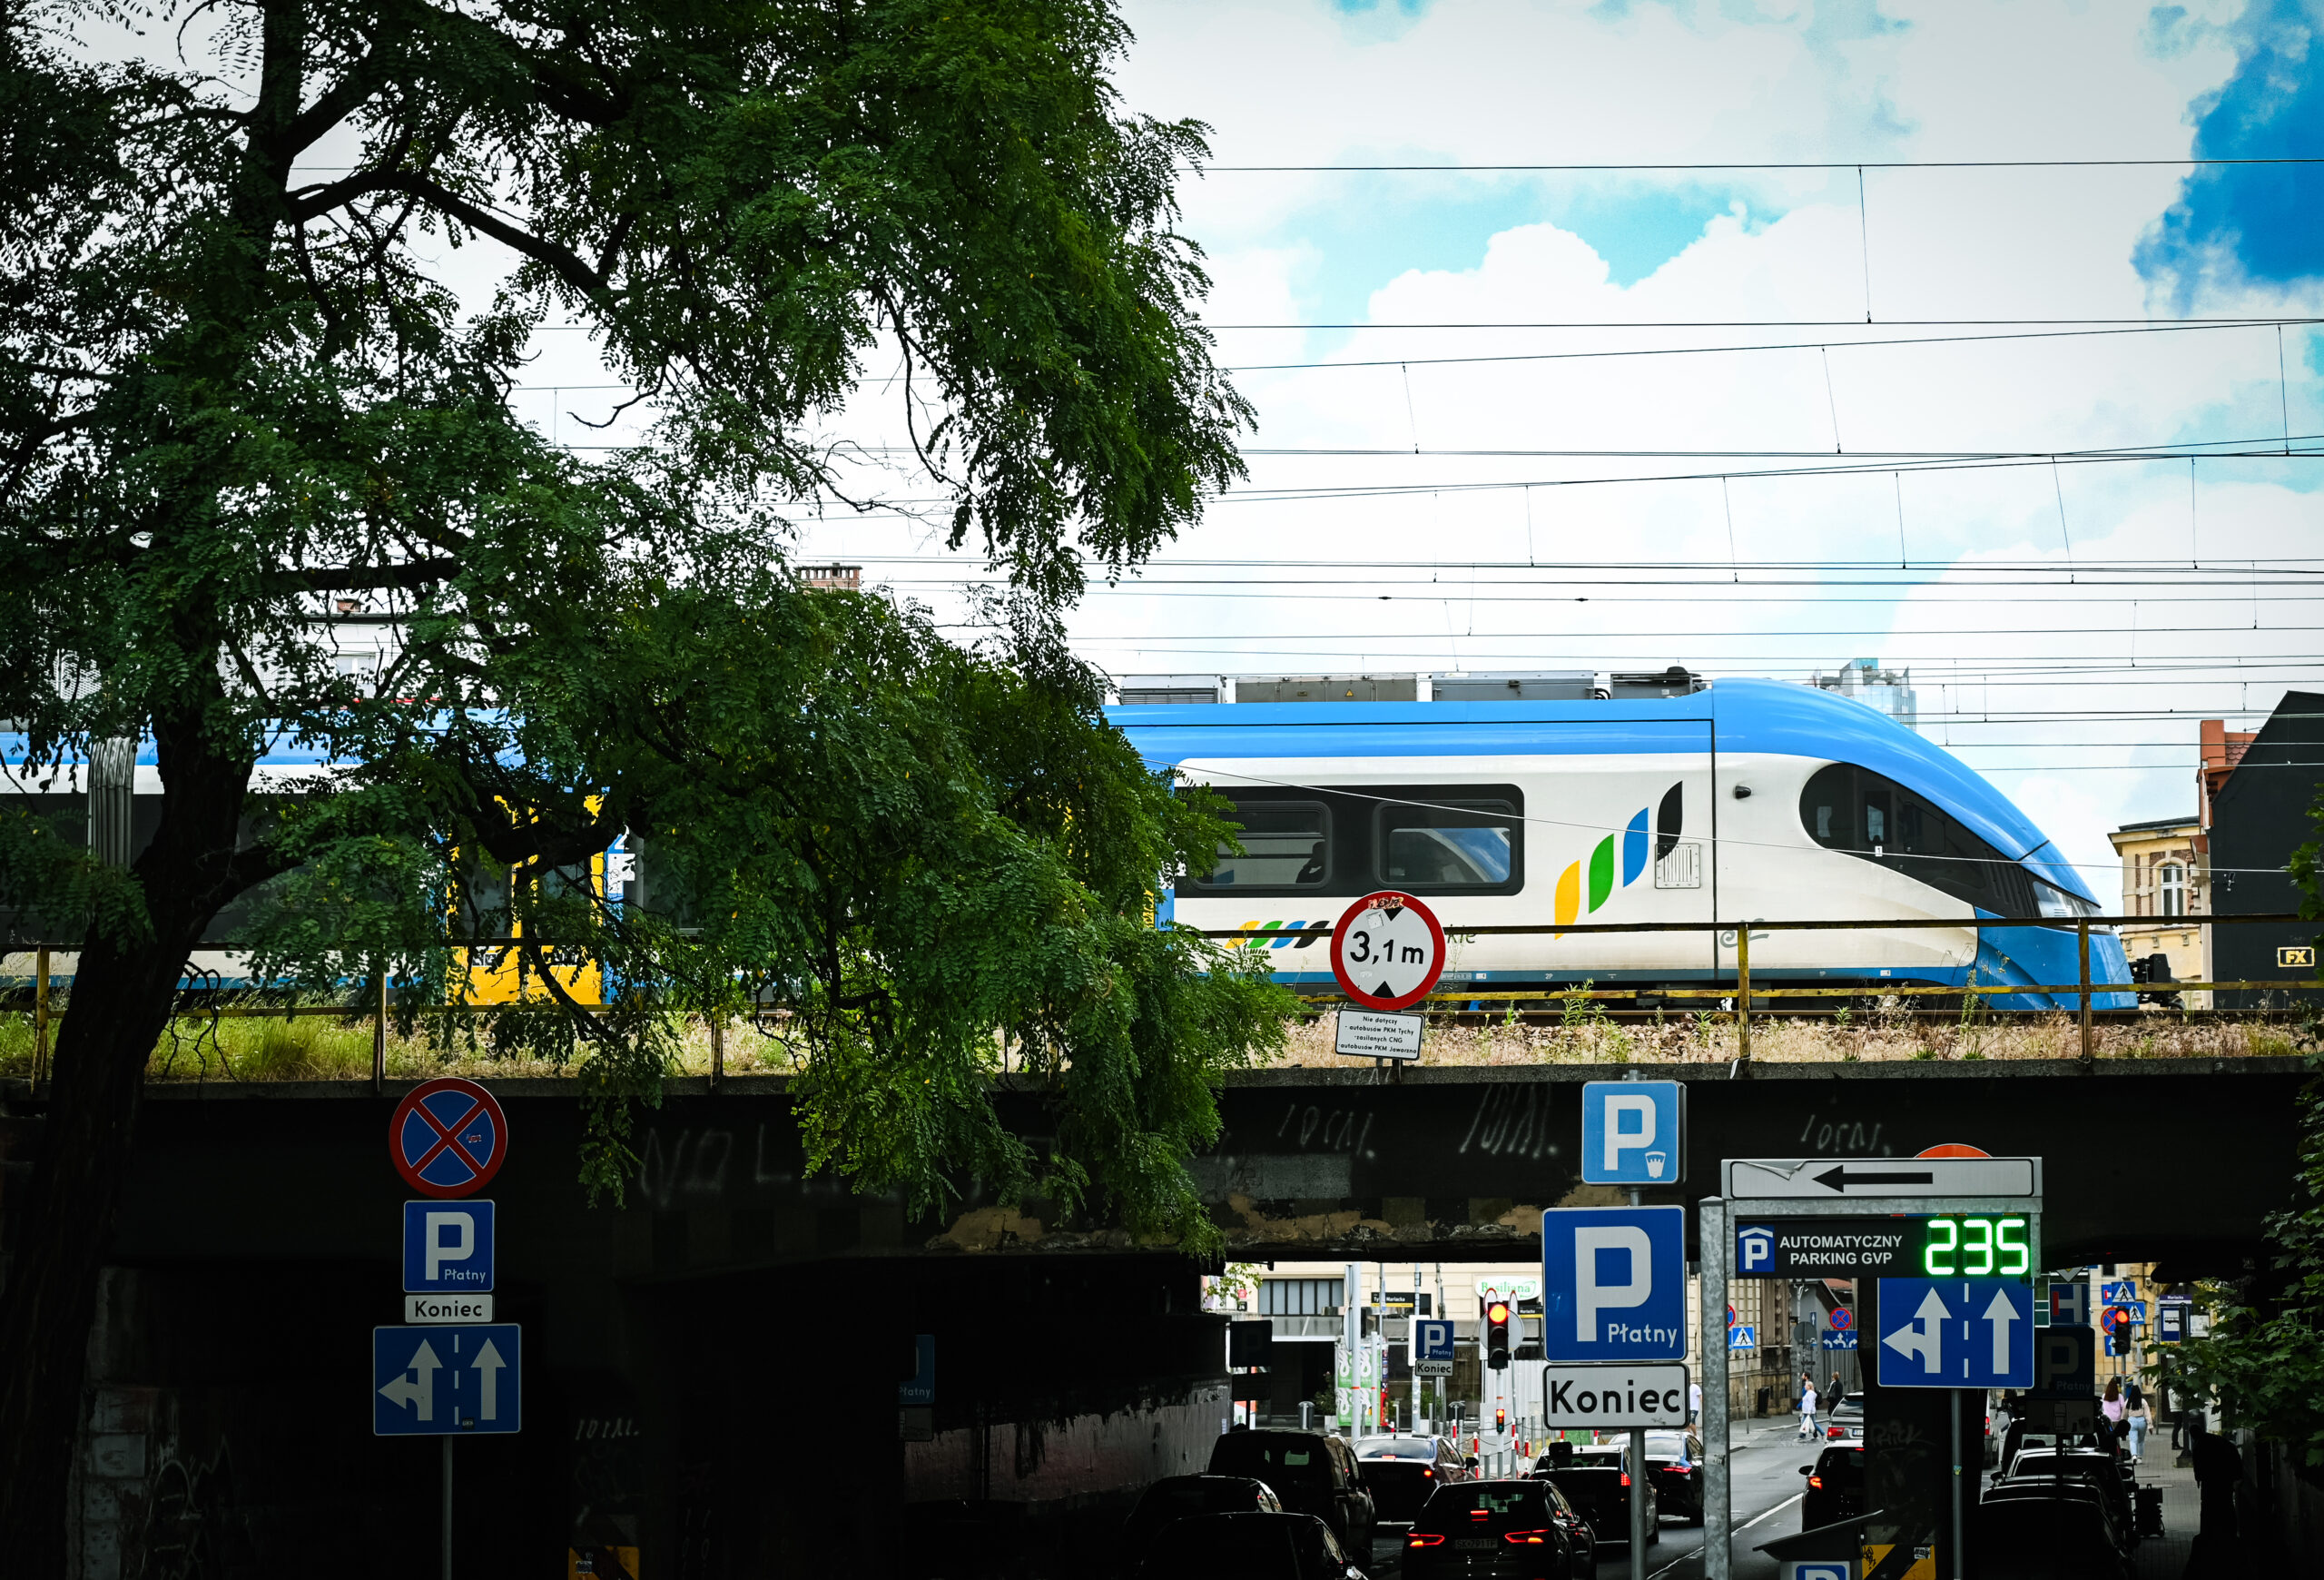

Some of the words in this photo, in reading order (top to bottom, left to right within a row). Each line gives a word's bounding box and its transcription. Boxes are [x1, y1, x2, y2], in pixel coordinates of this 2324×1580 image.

[2286, 950, 2307, 963] FX
[1375, 1016, 1397, 1025] dotyczy
[1604, 1094, 1656, 1170] P
[425, 1211, 475, 1280] P
[1745, 1238, 1768, 1269] P
[1779, 1235, 1903, 1249] AUTOMATYCZNY
[1925, 1219, 2030, 1276] 235
[1789, 1252, 1857, 1265] PARKING
[1861, 1251, 1893, 1265] GVP
[443, 1269, 487, 1284] Płatny
[1574, 1226, 1652, 1342] P
[415, 1300, 482, 1317] Koniec
[1424, 1325, 1445, 1355] P
[1608, 1323, 1678, 1348] Płatny
[1417, 1363, 1451, 1373] Koniec
[1551, 1379, 1681, 1414] Koniec
